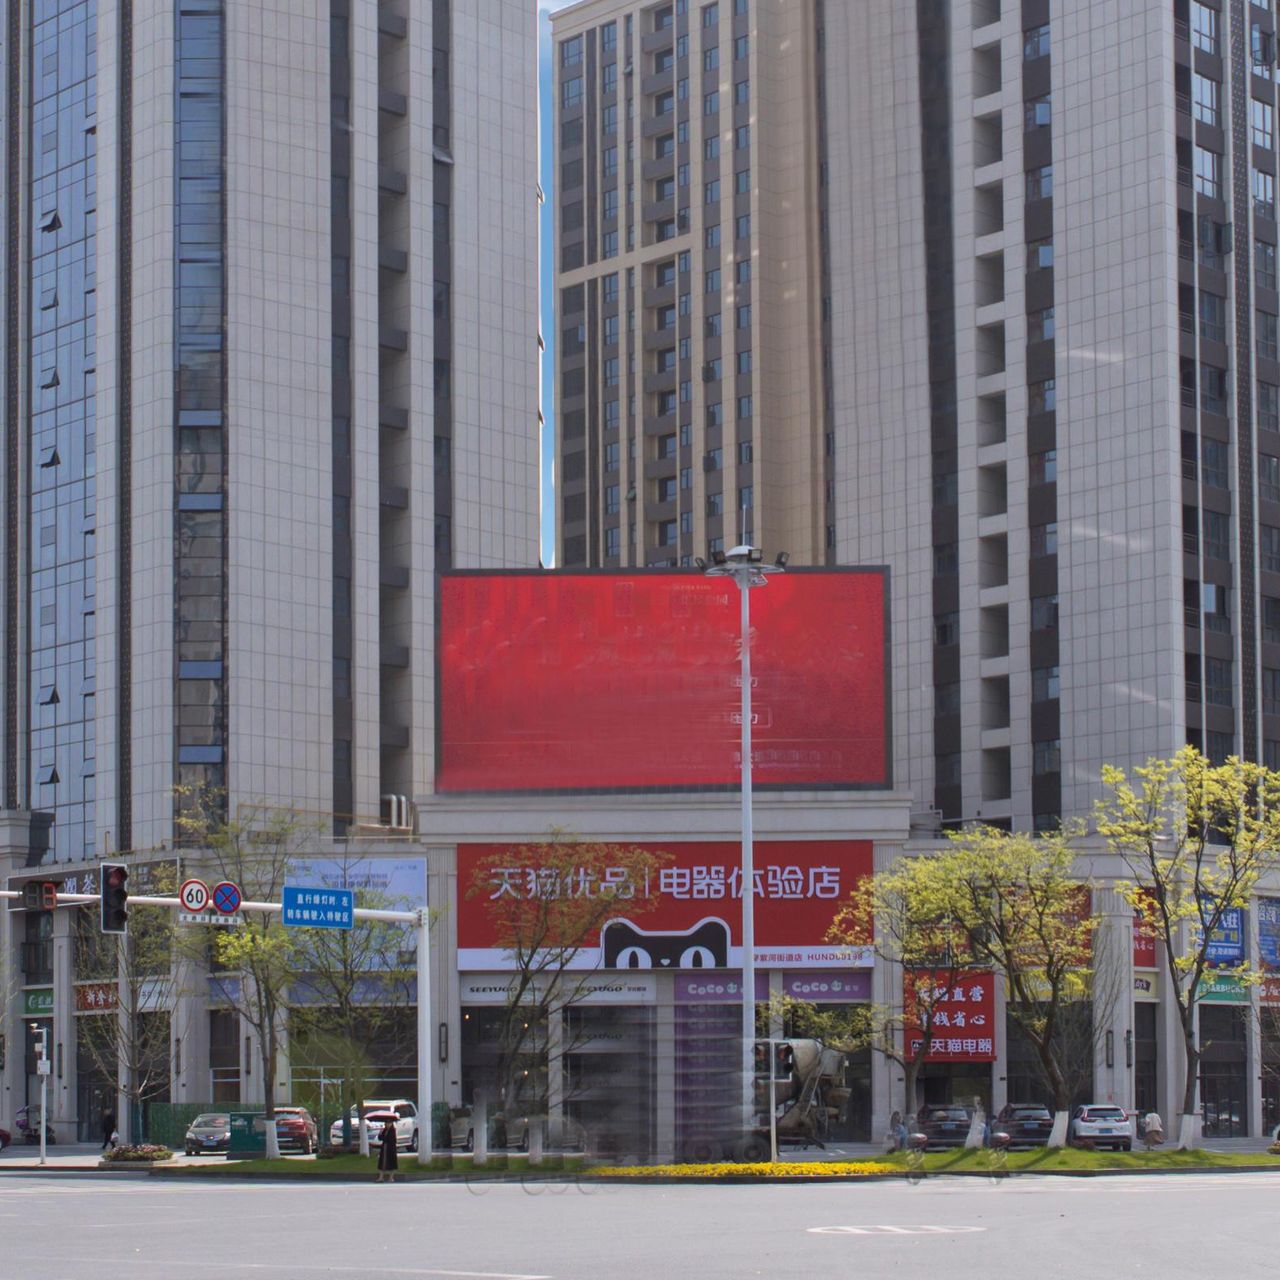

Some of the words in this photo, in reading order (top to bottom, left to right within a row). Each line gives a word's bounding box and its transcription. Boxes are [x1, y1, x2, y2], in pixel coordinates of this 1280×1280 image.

[659, 866, 841, 899] 电器体验店
[186, 888, 204, 904] 60
[931, 1038, 993, 1053] 天猫电器
